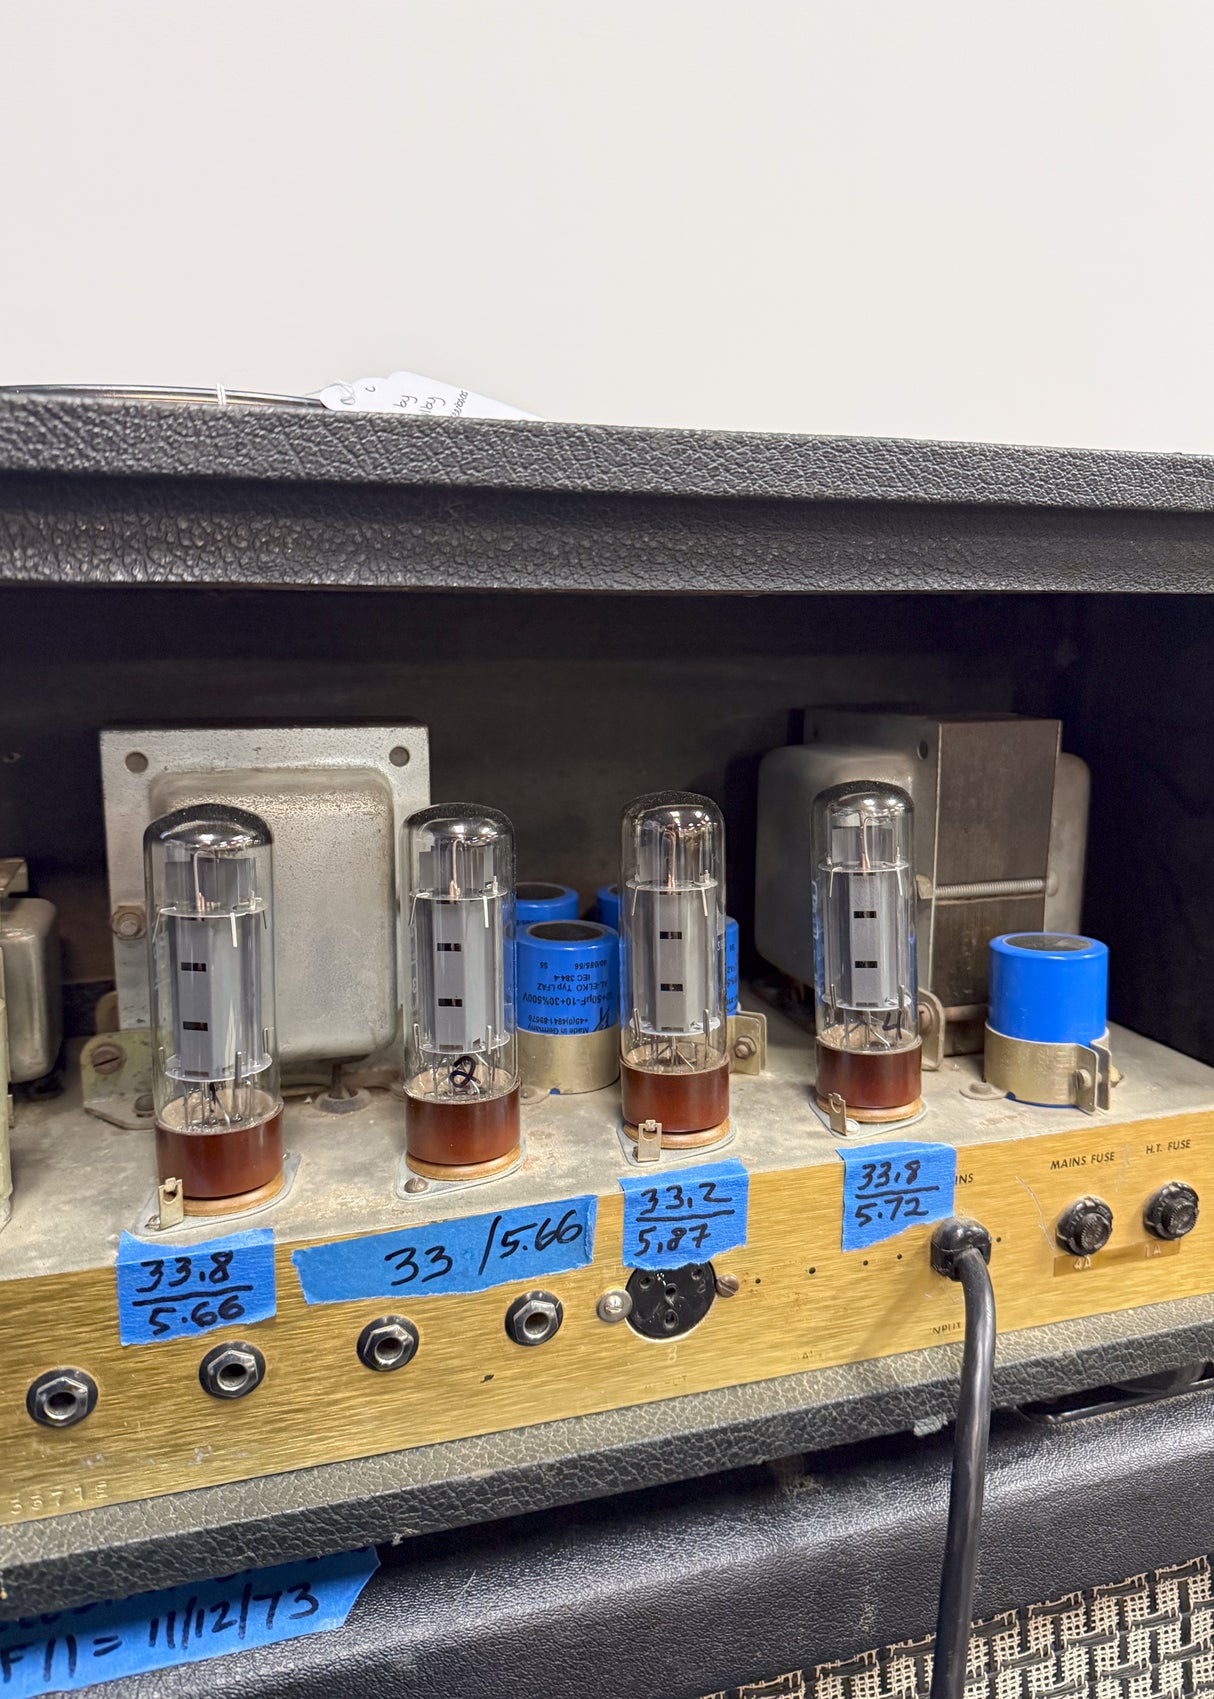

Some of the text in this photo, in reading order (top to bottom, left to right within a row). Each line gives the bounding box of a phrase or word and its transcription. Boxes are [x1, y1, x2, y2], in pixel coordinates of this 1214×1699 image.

[557, 983, 572, 992] Typ
[576, 974, 591, 982] IEC
[449, 1055, 482, 1089] 2
[1167, 1139, 1192, 1151] FUSE
[1050, 1151, 1116, 1170] MAINS FUSE
[955, 1173, 974, 1185] INS
[854, 1195, 929, 1227] 5.72
[384, 1245, 453, 1287] 33
[148, 1294, 246, 1337] 5.66
